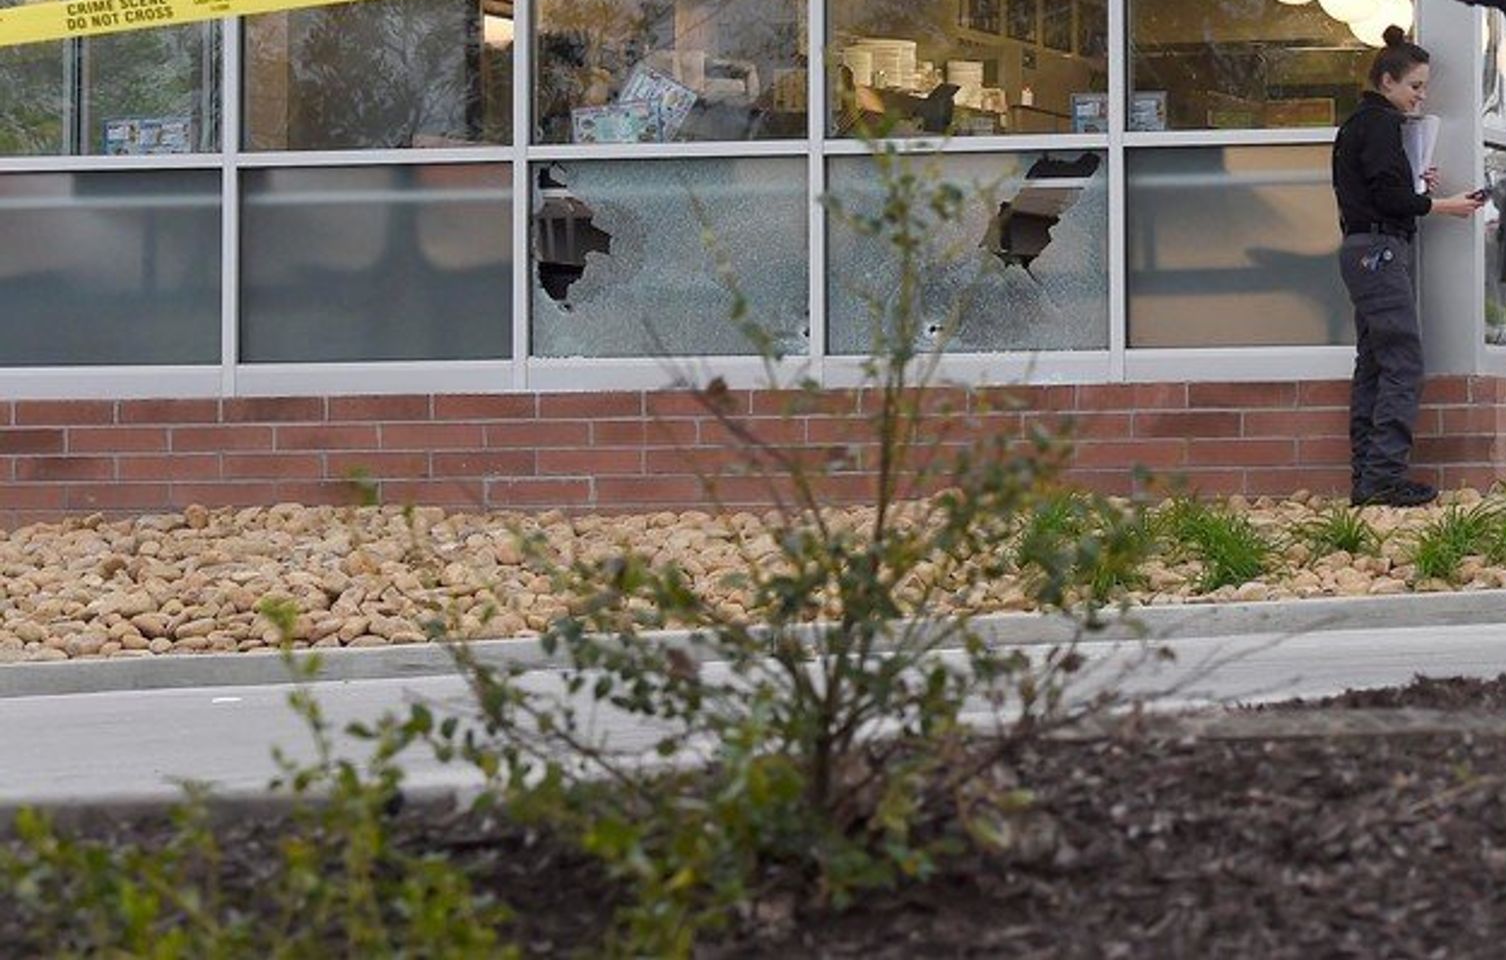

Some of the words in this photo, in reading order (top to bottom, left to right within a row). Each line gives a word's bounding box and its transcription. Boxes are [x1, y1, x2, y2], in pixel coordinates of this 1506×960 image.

[67, 2, 114, 17] CRIME
[67, 16, 87, 30] DO
[91, 12, 121, 27] NOT
[125, 6, 174, 23] CROSS
